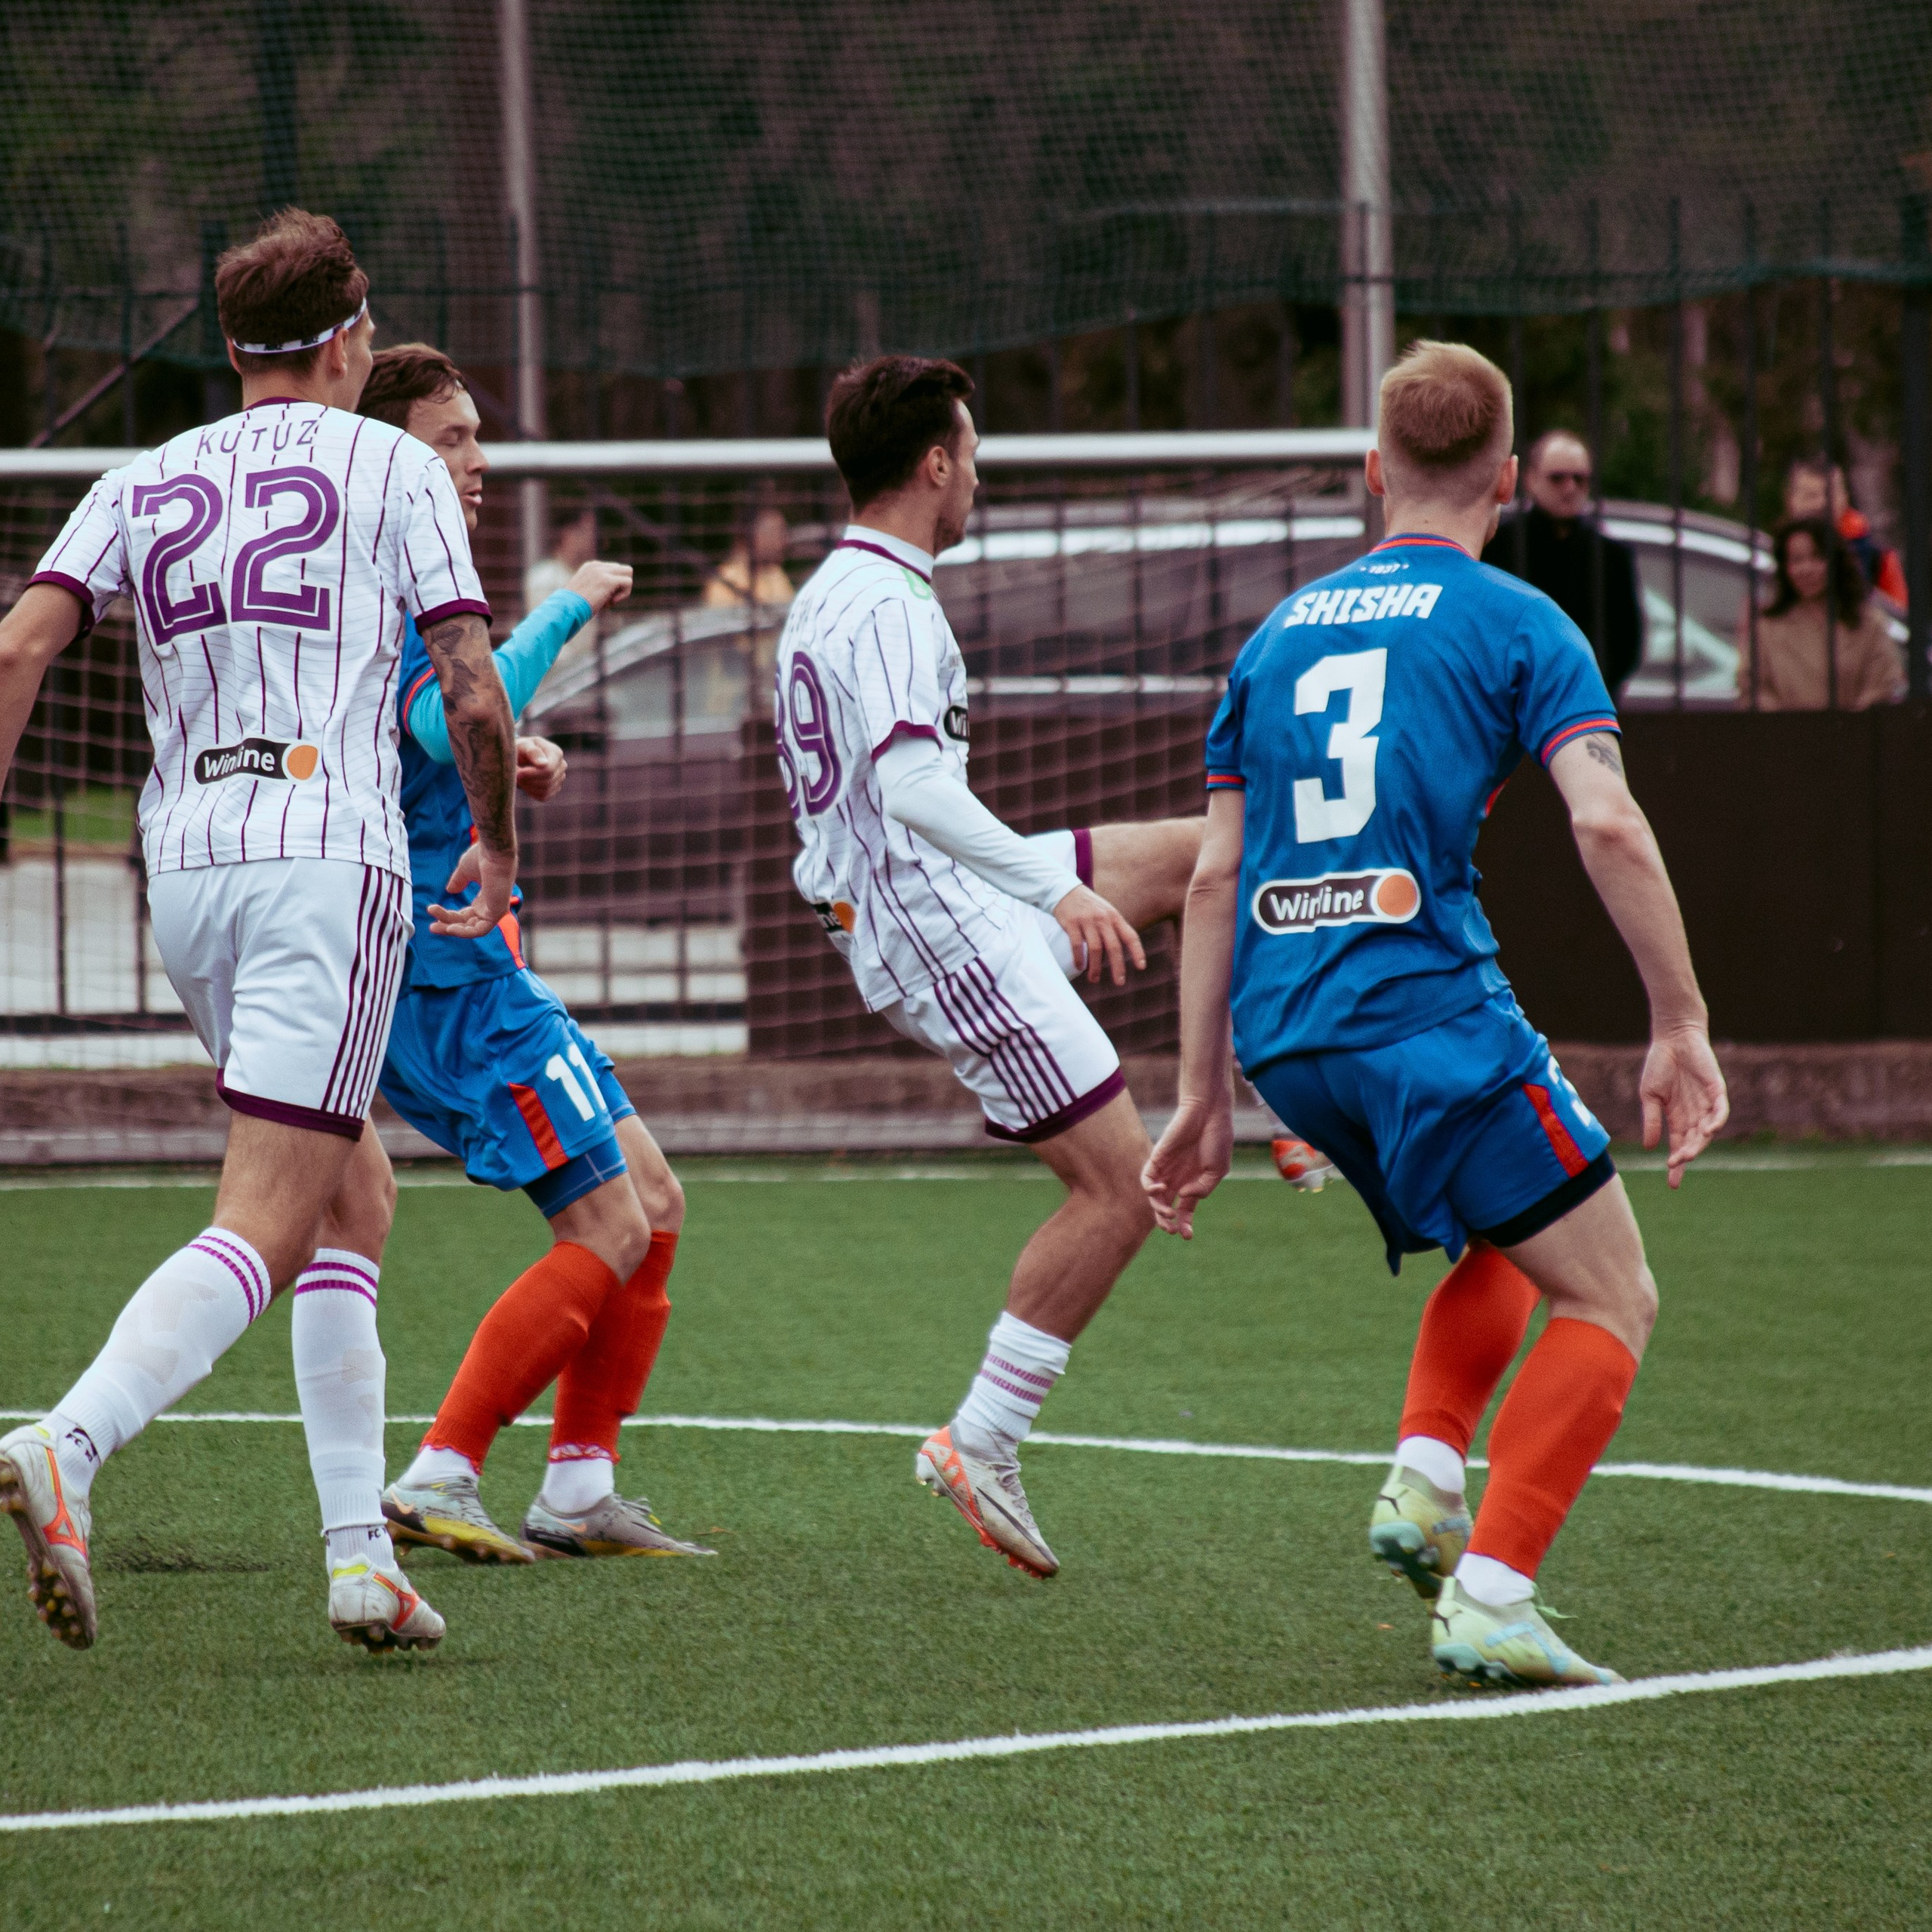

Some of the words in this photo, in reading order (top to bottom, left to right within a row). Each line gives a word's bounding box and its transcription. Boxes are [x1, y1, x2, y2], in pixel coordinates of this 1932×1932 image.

[196, 419, 319, 457] KUTUZ
[132, 466, 340, 646] 22
[1284, 583, 1443, 628] SHISHA
[204, 746, 275, 778] Winline
[1293, 647, 1388, 844] 3
[1269, 886, 1364, 921] Winline
[545, 1042, 607, 1122] 11
[368, 1527, 381, 1541] FC
